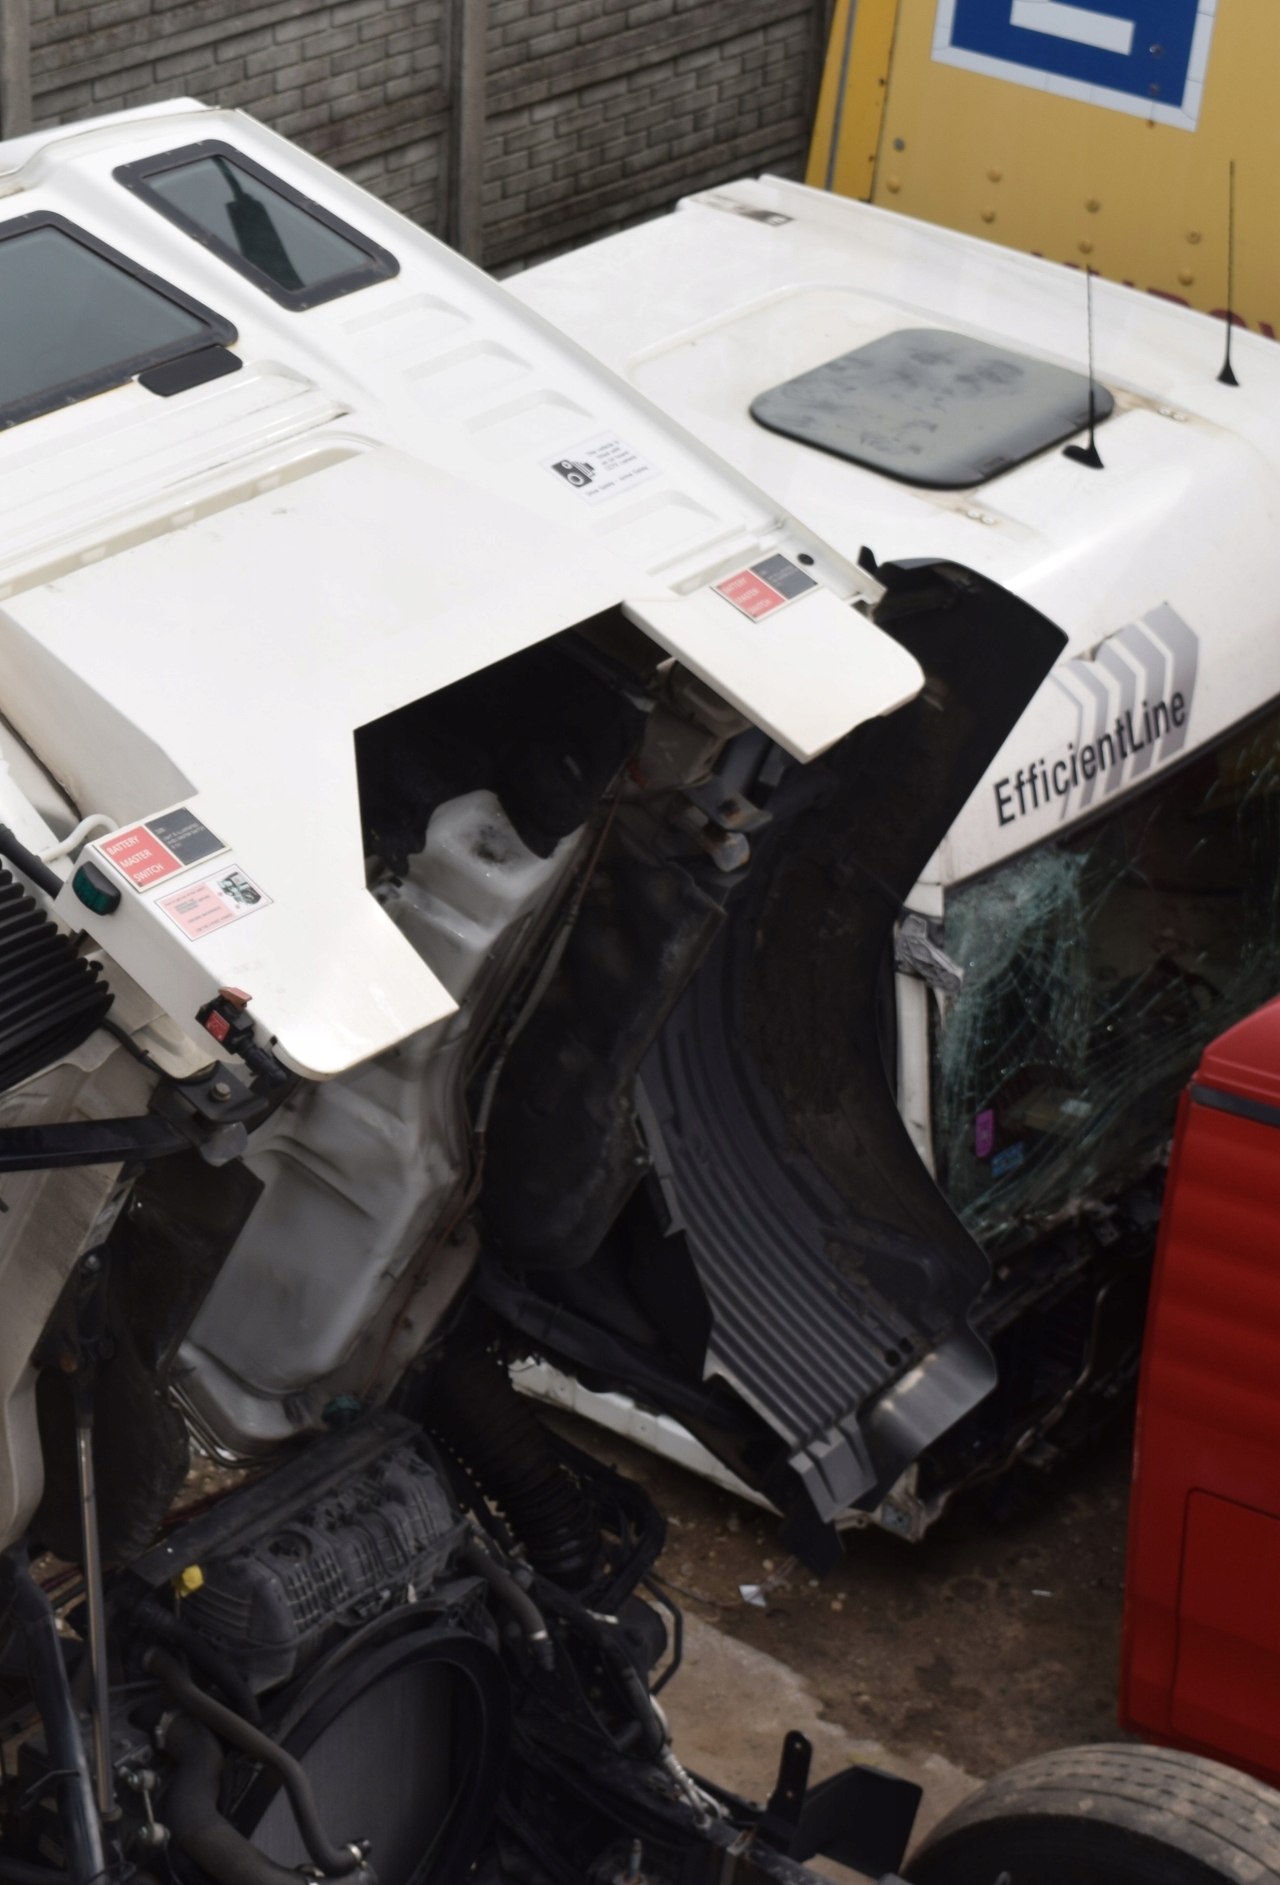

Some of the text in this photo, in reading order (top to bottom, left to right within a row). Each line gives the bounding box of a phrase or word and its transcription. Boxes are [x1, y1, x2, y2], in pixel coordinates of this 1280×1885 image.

[993, 691, 1186, 827] EfficientLine
[106, 835, 139, 855] BATTERY
[119, 849, 152, 868] MASTER
[132, 863, 164, 881] SWITCH
